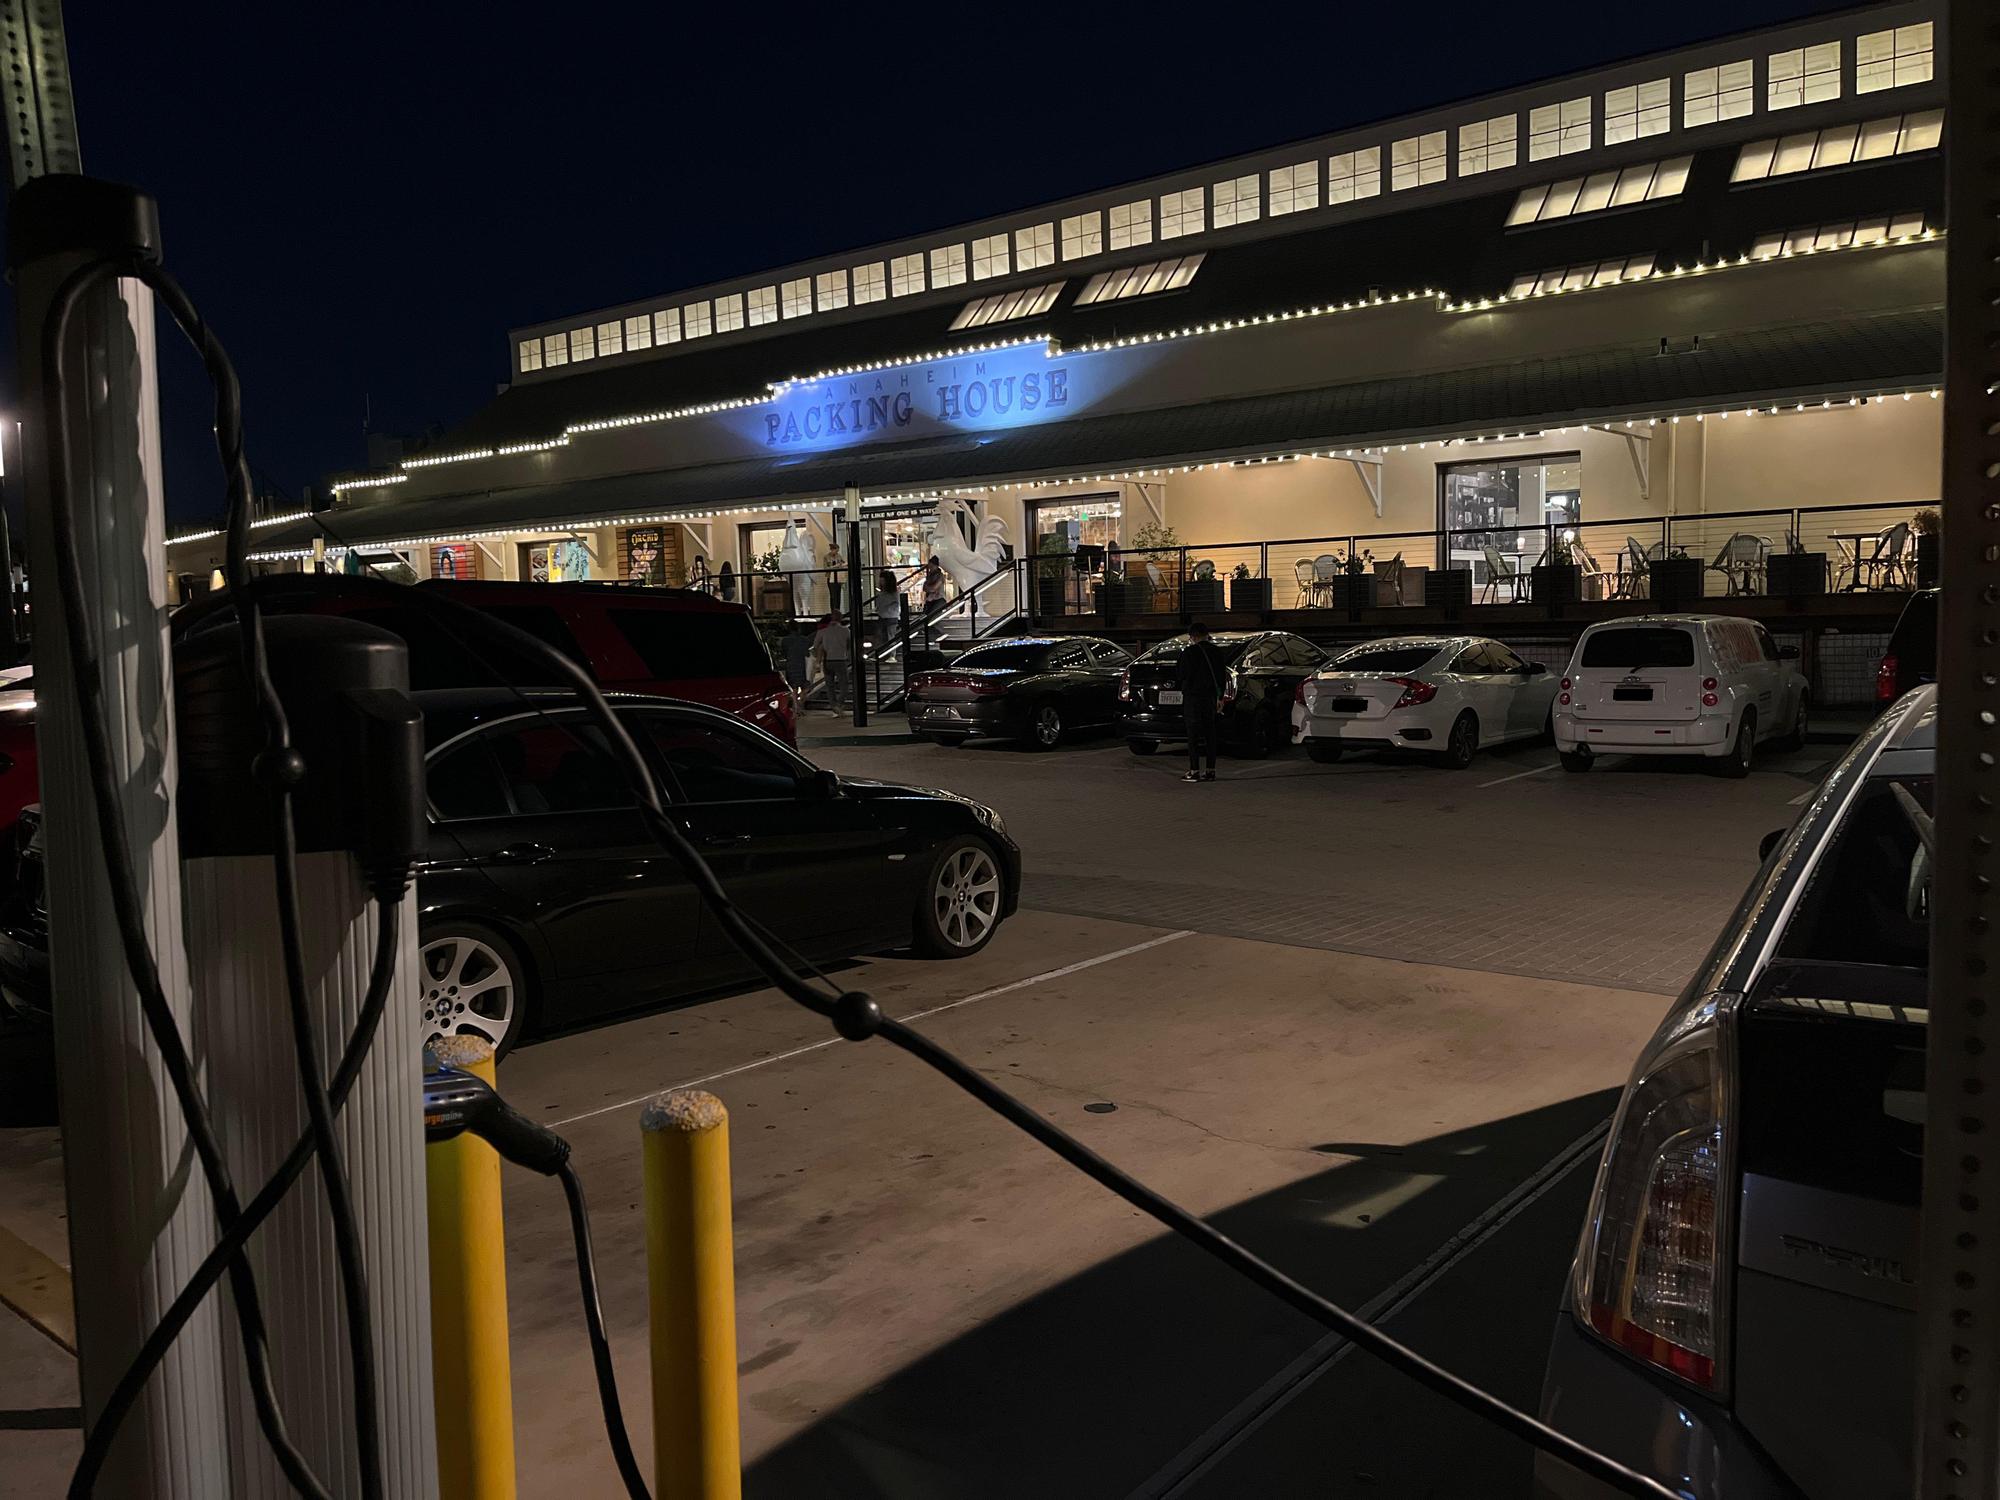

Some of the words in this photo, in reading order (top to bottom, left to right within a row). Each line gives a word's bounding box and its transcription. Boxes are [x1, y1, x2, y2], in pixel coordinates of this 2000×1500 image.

[764, 391, 914, 446] PACKING
[936, 368, 1069, 422] HOUSE
[825, 361, 988, 400] ANAHEIM
